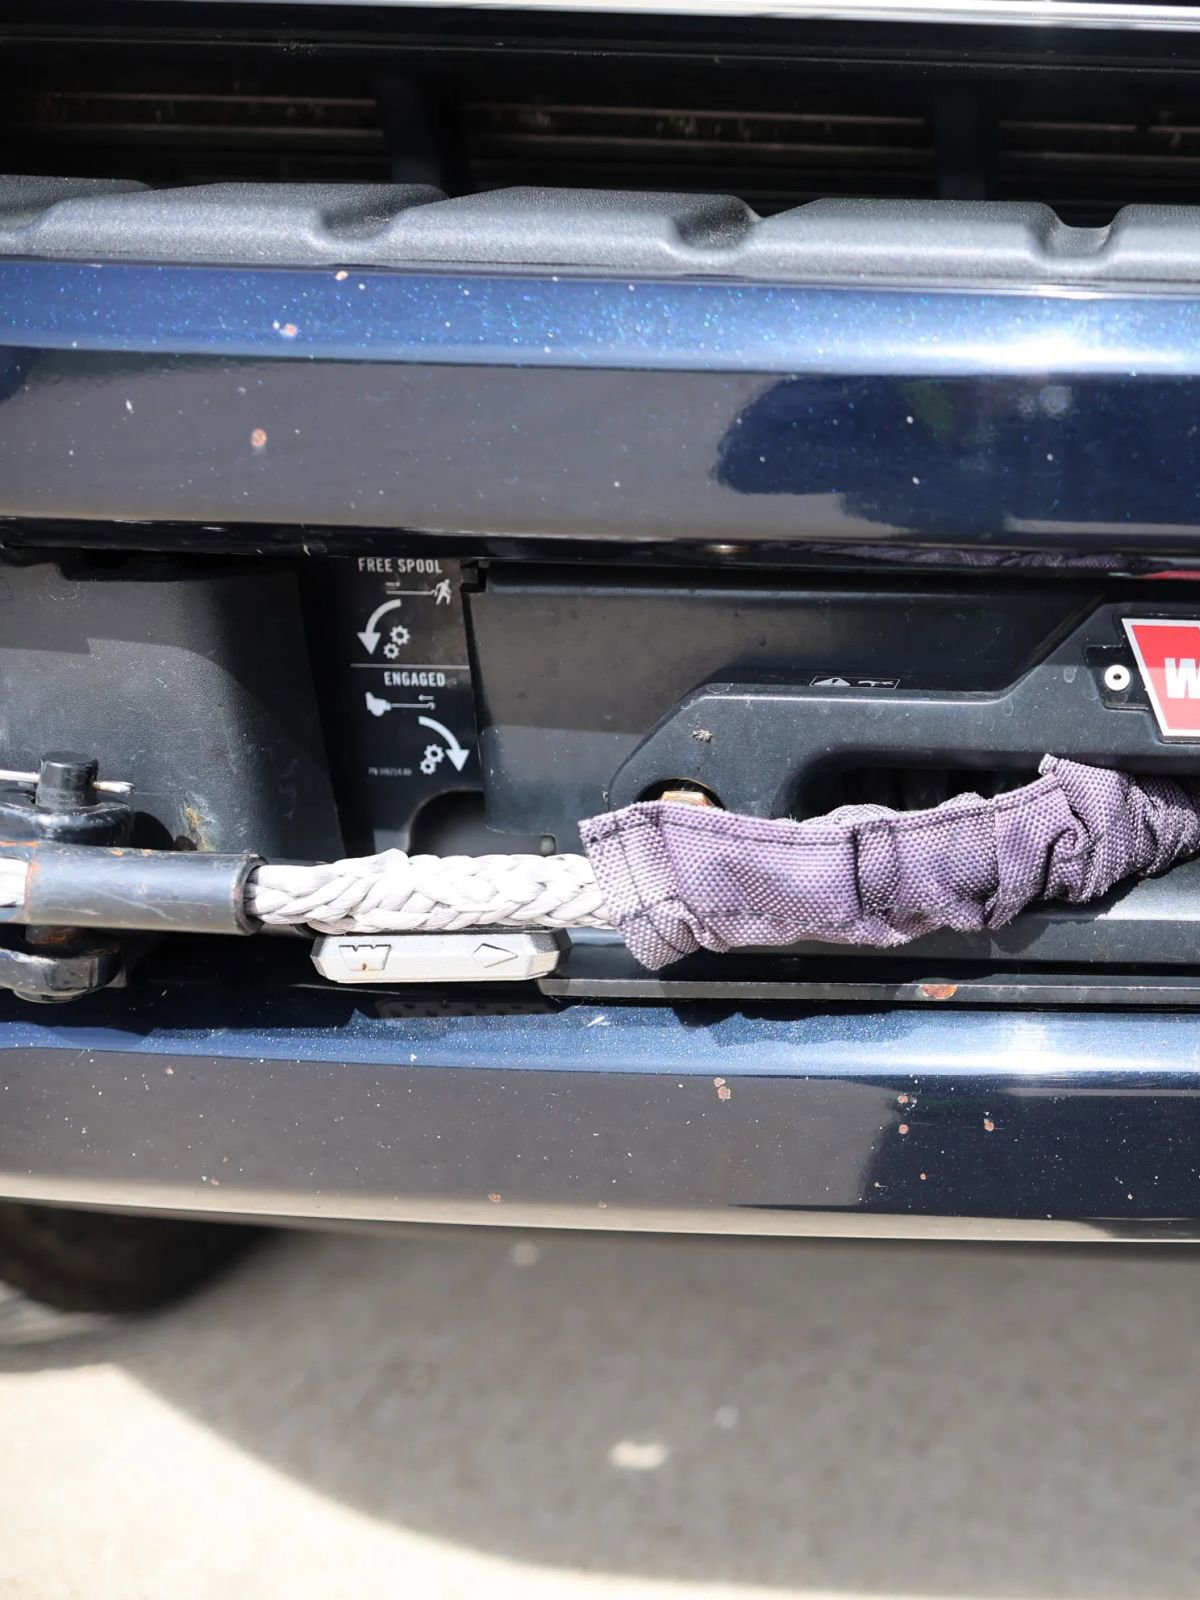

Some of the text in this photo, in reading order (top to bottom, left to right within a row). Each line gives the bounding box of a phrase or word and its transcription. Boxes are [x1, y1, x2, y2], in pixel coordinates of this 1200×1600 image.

[358, 558, 443, 574] FREE SPOOL
[383, 671, 446, 687] ENGAGED
